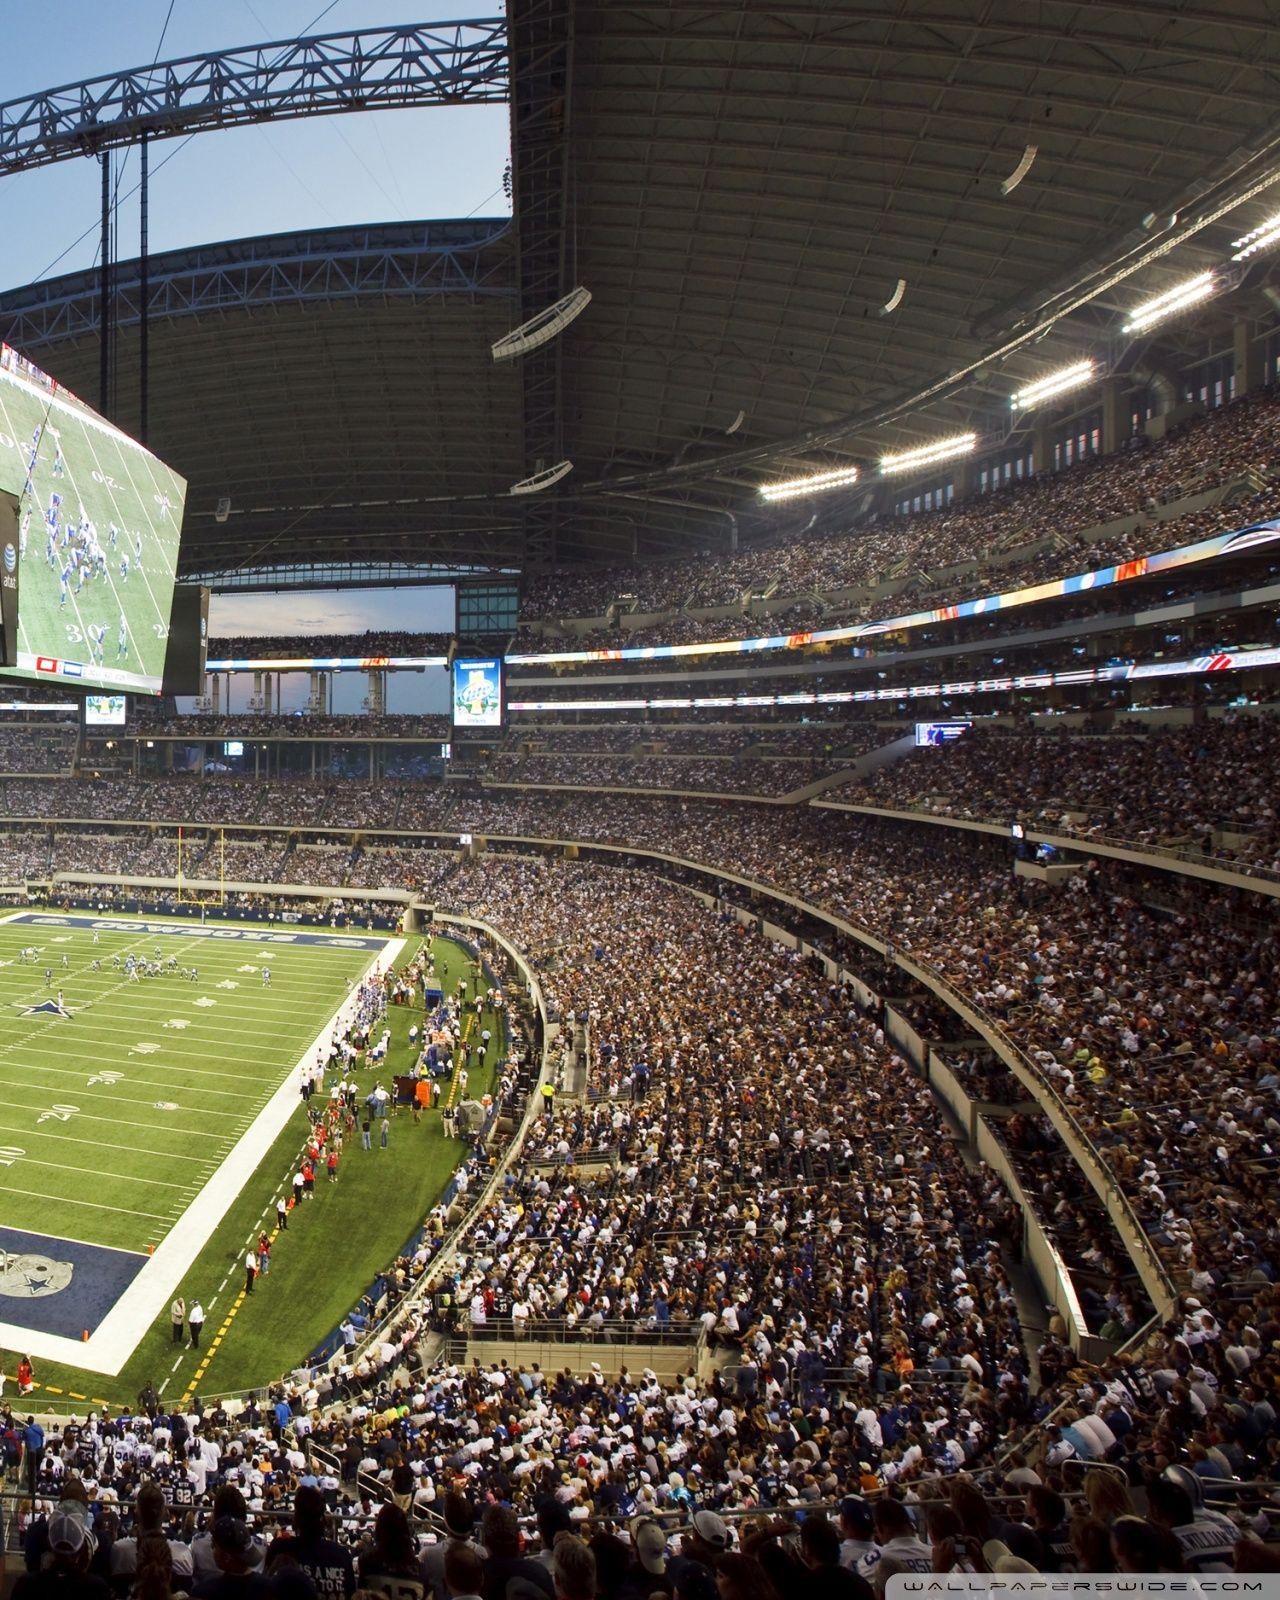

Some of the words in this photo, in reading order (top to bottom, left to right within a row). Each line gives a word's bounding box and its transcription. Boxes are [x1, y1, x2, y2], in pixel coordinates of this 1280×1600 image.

[91, 920, 298, 943] COWBOYS
[89, 1070, 124, 1085] 30
[41, 1104, 80, 1121] 20
[325, 1566, 346, 1581] NICE
